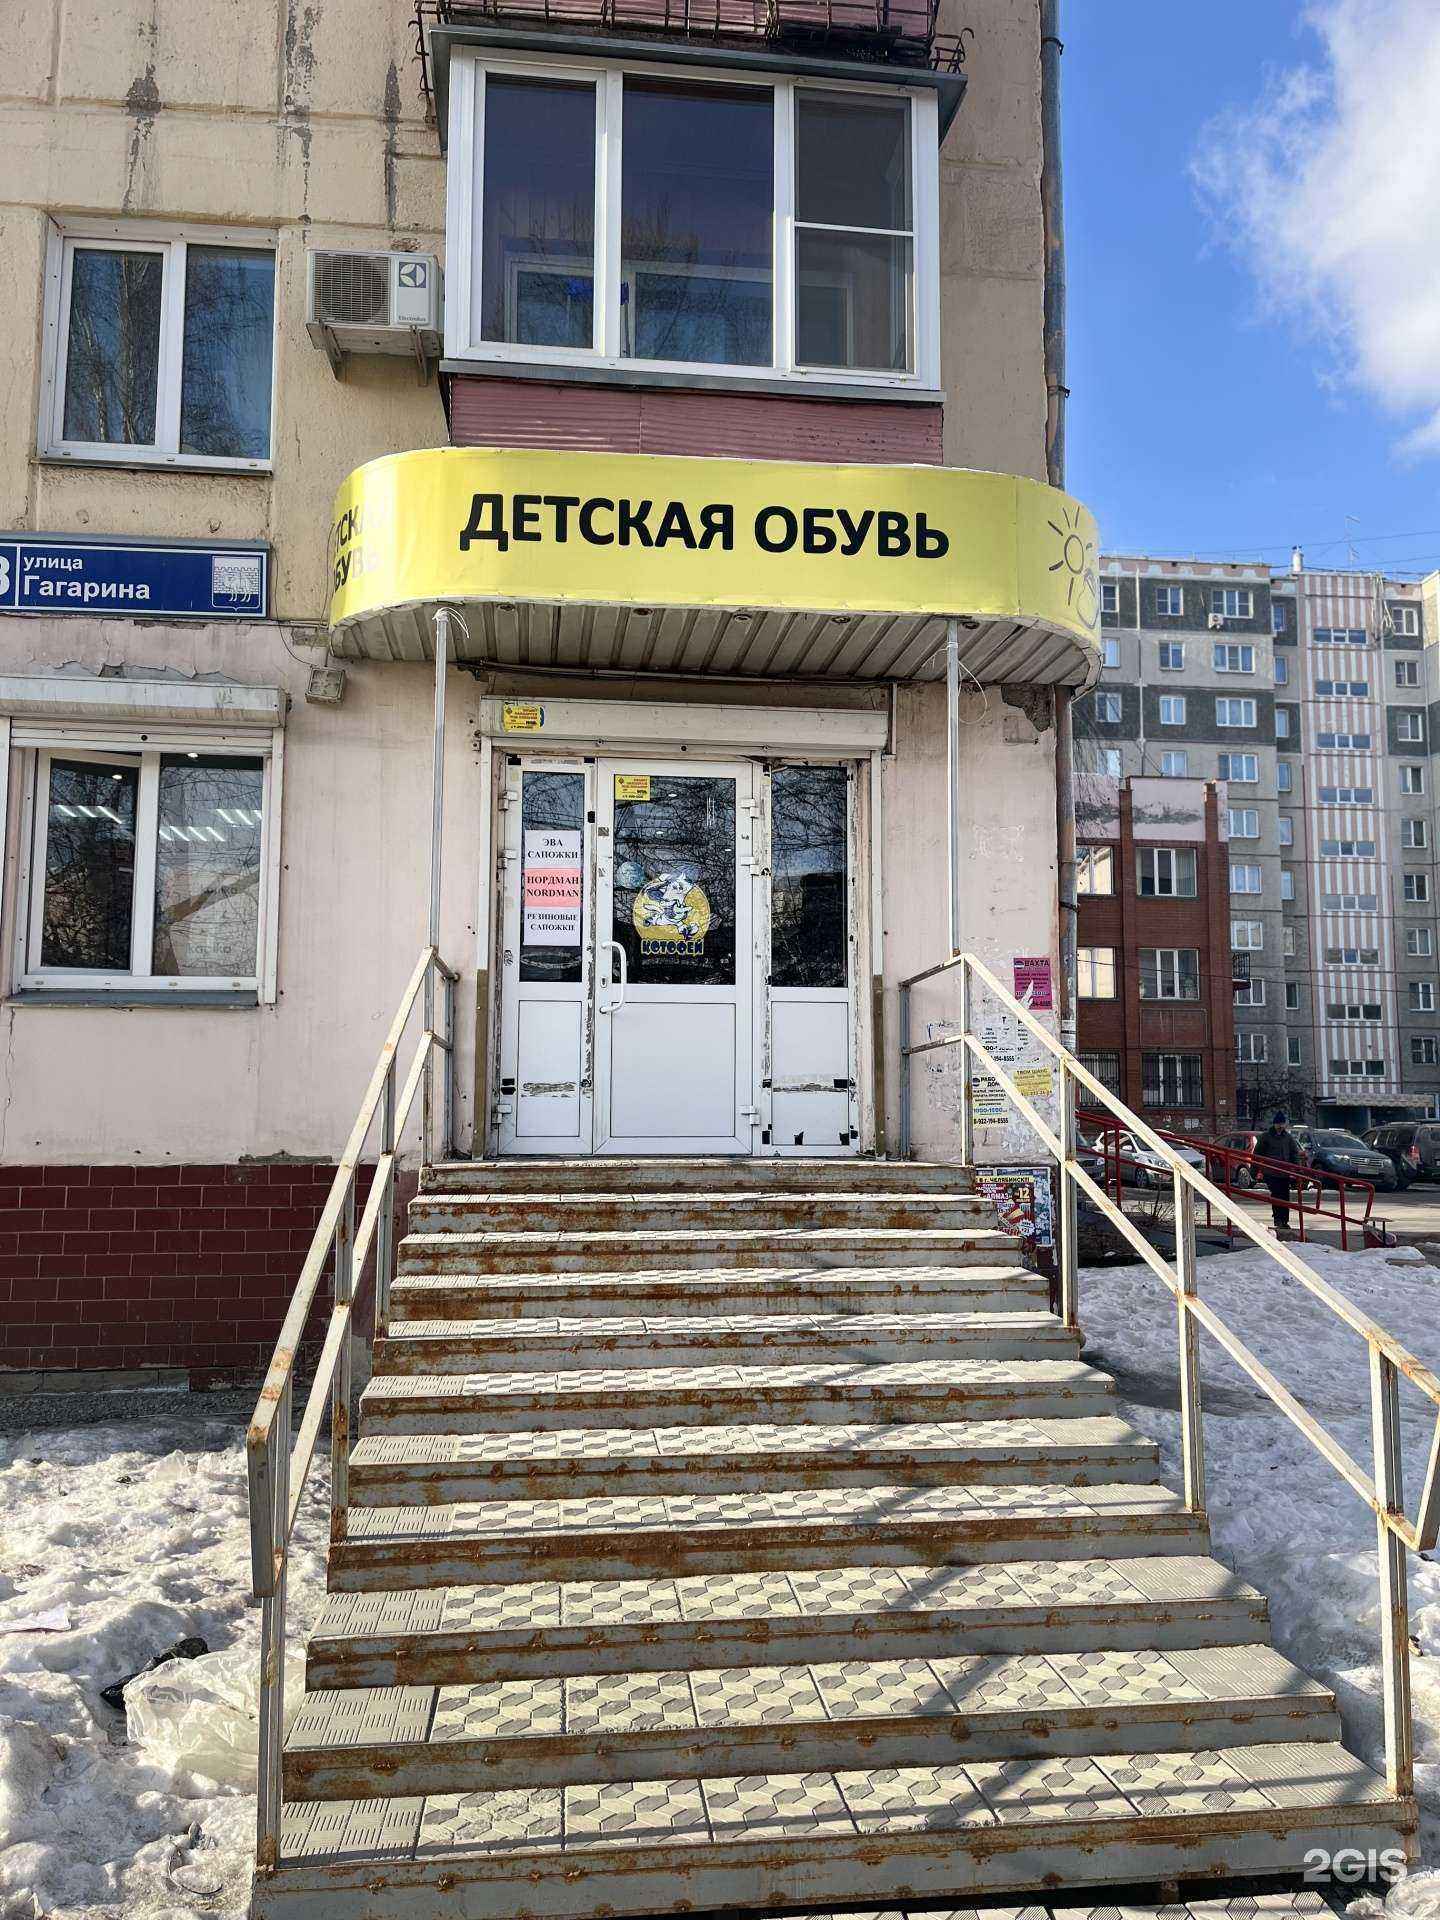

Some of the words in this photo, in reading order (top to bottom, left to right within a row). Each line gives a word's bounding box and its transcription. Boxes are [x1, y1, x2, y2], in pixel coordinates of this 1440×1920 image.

[459, 493, 734, 551] ДЕТСКАЯ
[753, 505, 950, 559] ОБУВЬ
[23, 556, 83, 572] улица
[23, 575, 151, 602] Гагарина
[542, 838, 563, 847] ЭВА
[527, 850, 578, 859] САПОЖКИ
[527, 876, 579, 886] НОРДМАН
[526, 888, 579, 897] NORDMAN
[527, 913, 577, 921] РЕЗИНОВЫЕ
[641, 939, 704, 955] КОТОФЕЙ
